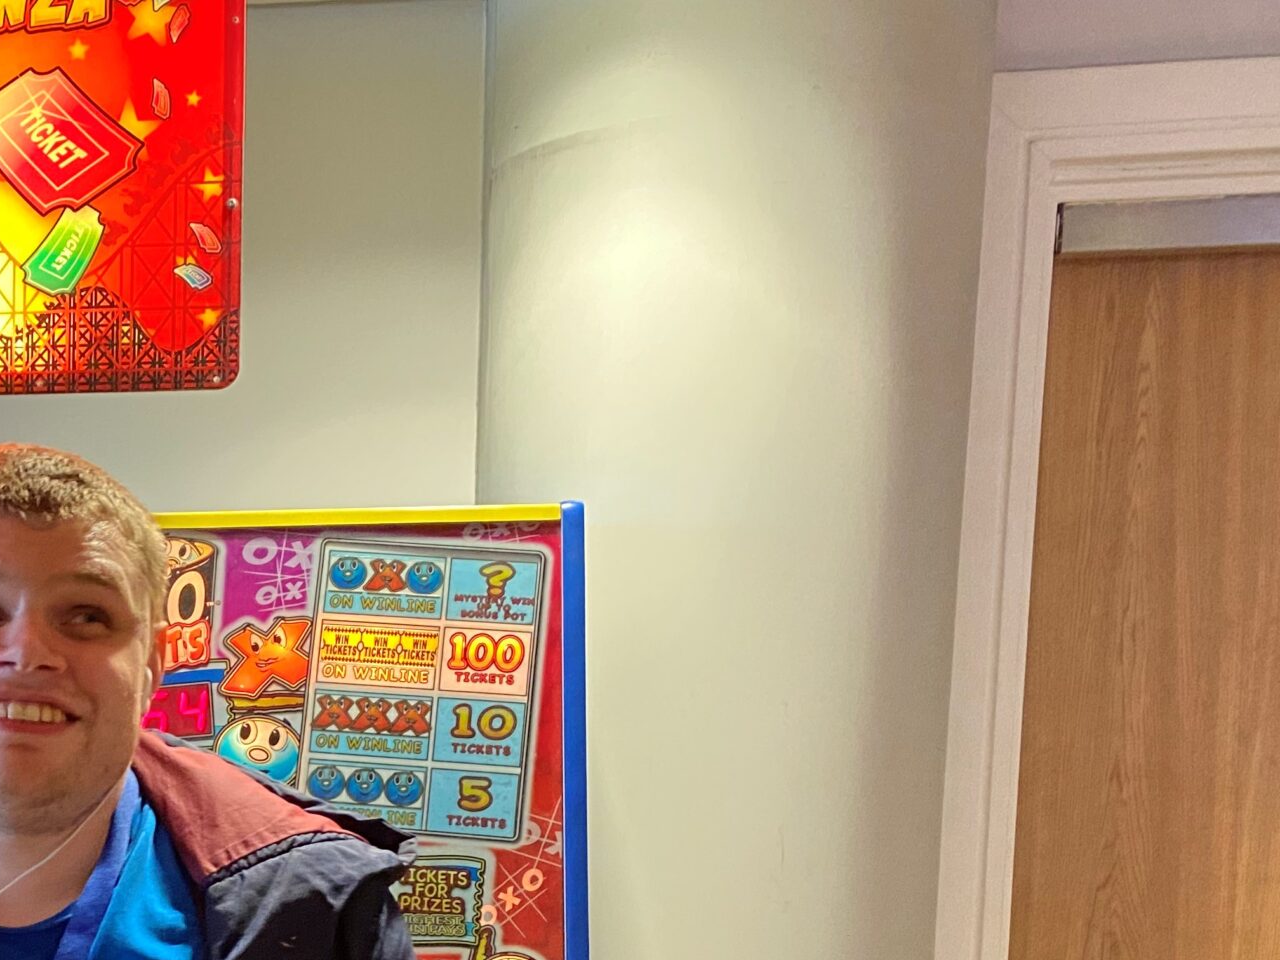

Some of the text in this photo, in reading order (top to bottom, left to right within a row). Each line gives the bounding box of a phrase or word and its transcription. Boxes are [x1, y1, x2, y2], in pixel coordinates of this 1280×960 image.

[20, 107, 88, 168] TICKET
[51, 224, 86, 272] TICKET
[329, 594, 435, 613] ON WINLINE
[335, 633, 427, 650] WIN WIN WIN
[324, 644, 436, 662] TICKETS TICKETS TICKETS
[447, 631, 525, 673] 100
[322, 663, 430, 684] ON WINLINE
[455, 671, 515, 686] TICKETS
[450, 703, 518, 741] 10
[315, 733, 423, 755] ON WINLINE
[451, 742, 512, 757] TICKETS
[457, 775, 493, 812] 5
[446, 814, 507, 830] TICKETS
[414, 883, 449, 899] FOR
[400, 896, 462, 914] PRIZES
